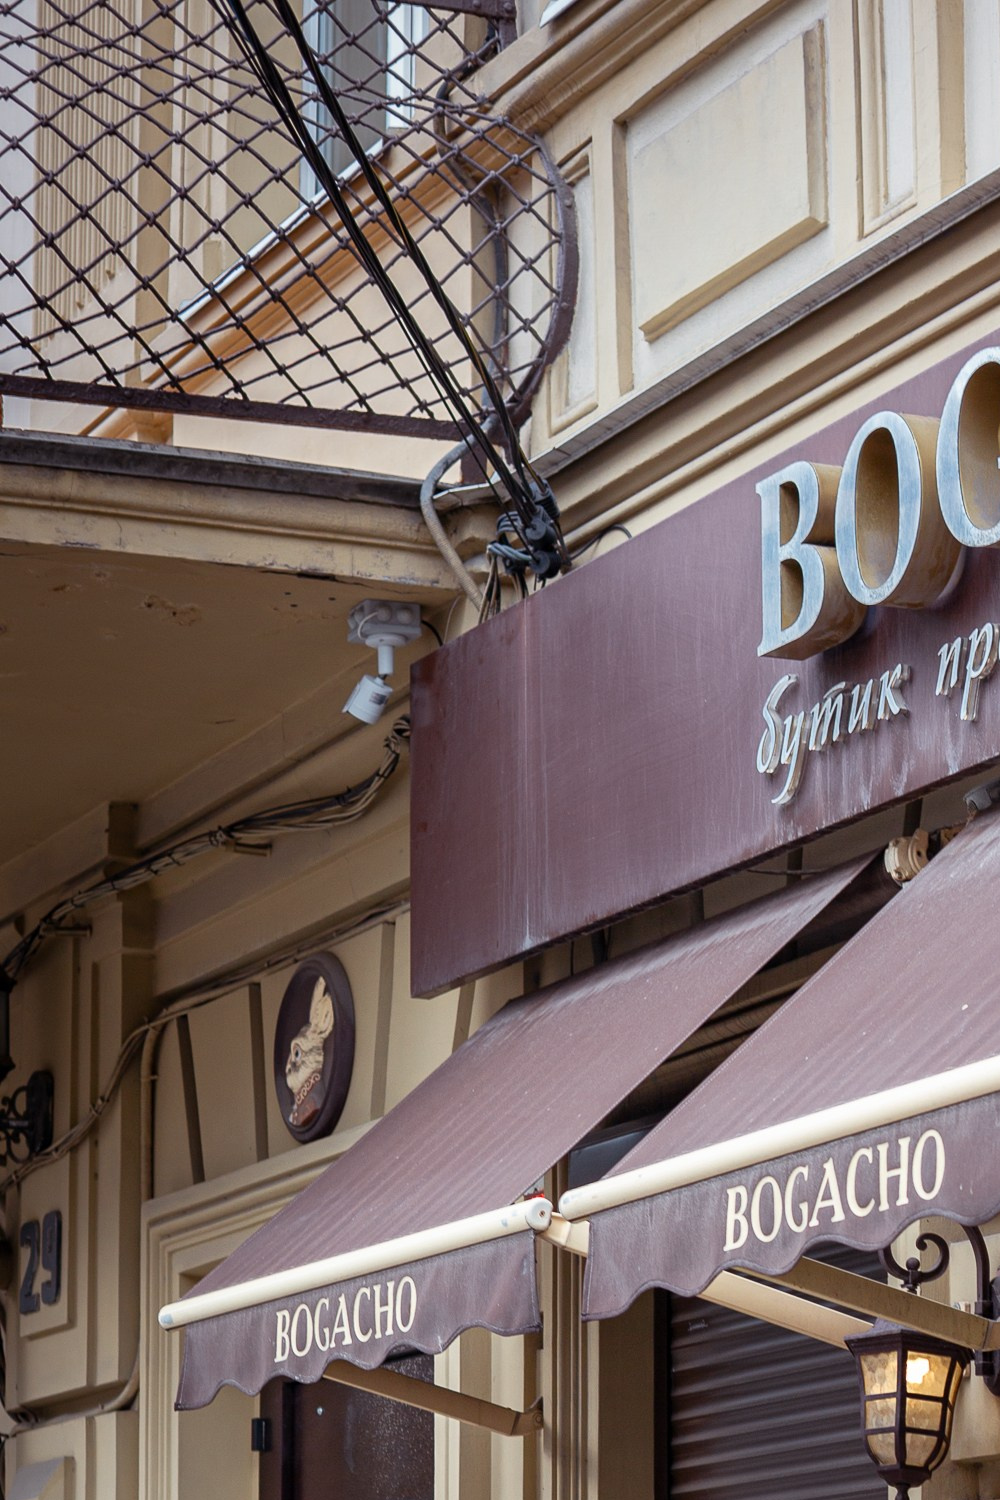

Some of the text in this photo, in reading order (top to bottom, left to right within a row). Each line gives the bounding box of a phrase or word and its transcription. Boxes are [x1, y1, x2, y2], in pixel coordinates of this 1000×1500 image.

[756, 672, 911, 804] бутик
[722, 1128, 946, 1252] BOGACHO
[19, 1209, 62, 1315] 29
[273, 1275, 418, 1363] BOGACHO
